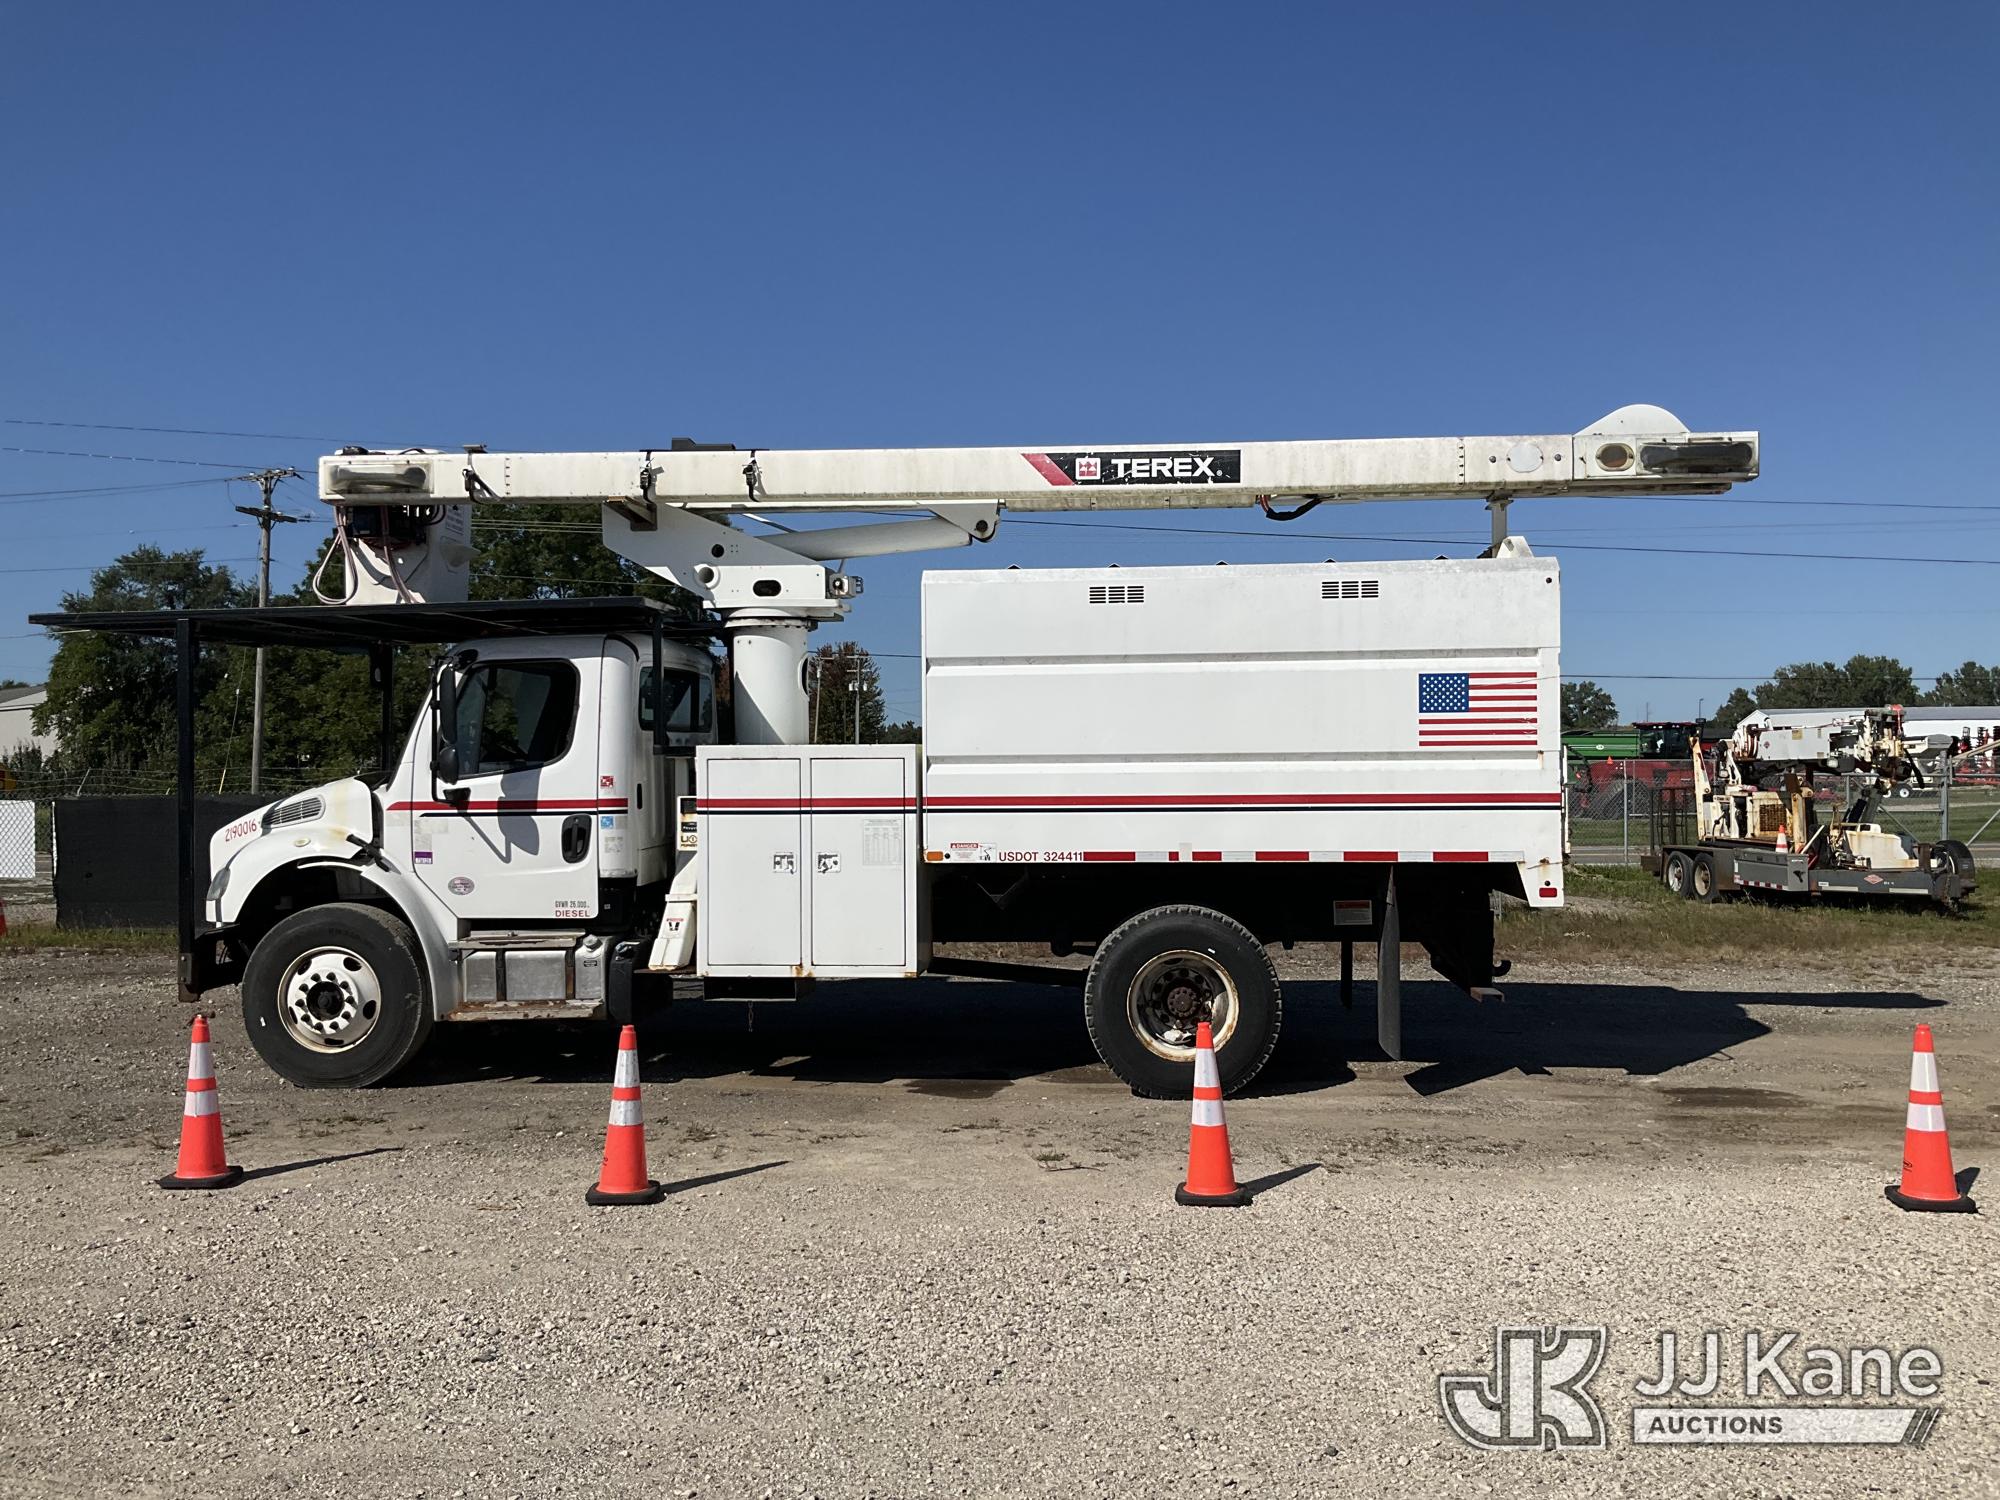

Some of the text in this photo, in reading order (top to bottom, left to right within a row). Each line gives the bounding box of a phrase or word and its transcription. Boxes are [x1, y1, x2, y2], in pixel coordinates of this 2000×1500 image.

[1111, 457, 1216, 478] TEREX
[225, 818, 258, 842] 2190016
[999, 851, 1083, 862] USDOT 324411
[555, 909, 591, 918] DIESEL
